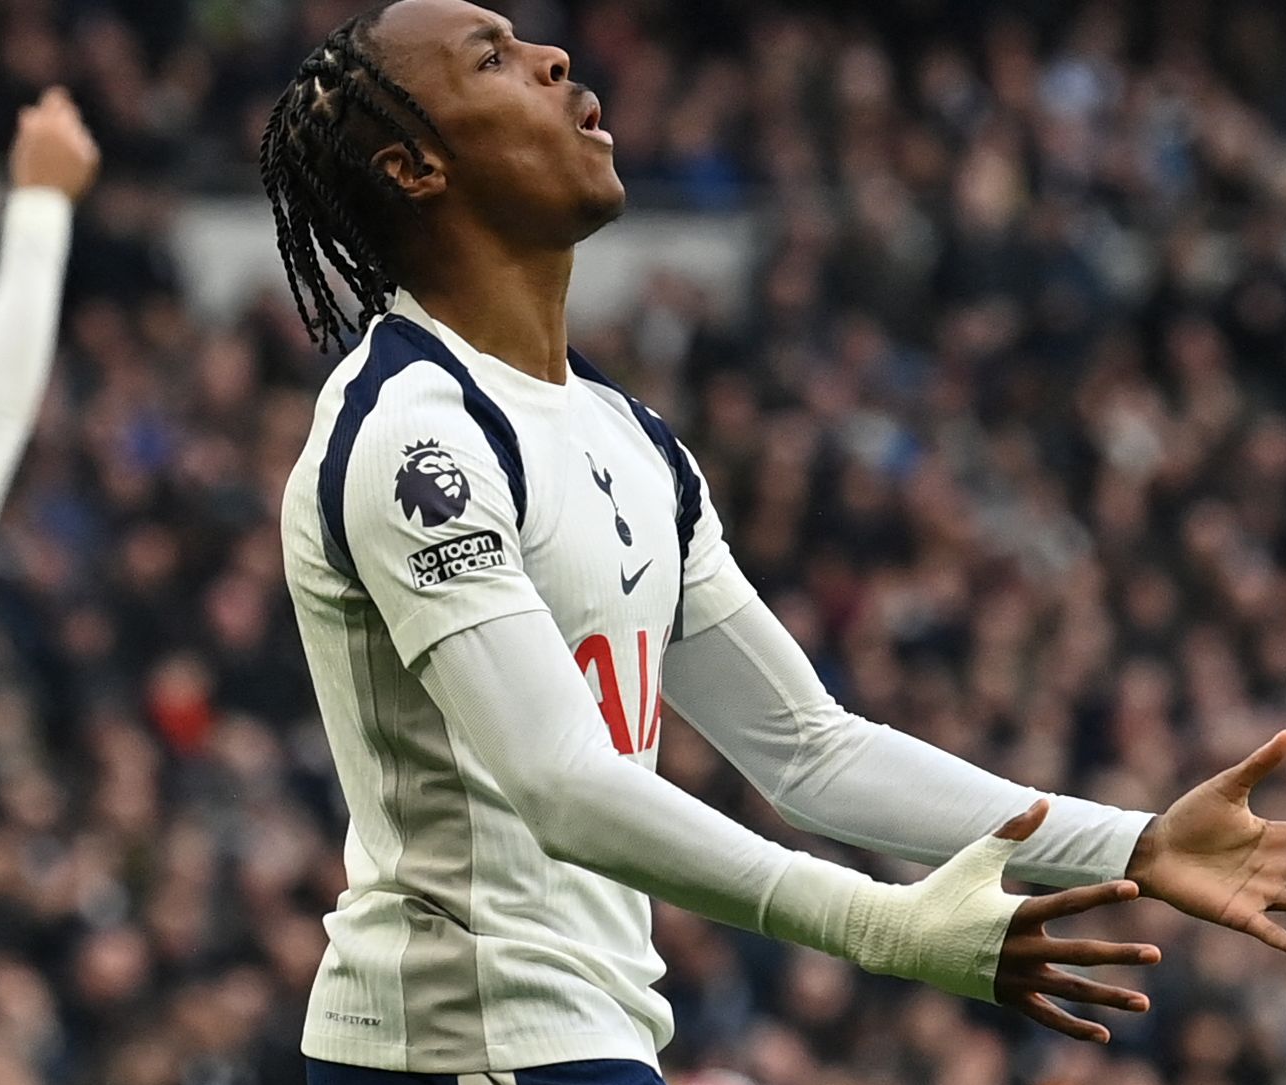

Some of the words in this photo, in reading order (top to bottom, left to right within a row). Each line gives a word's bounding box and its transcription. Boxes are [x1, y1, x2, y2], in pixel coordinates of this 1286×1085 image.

[408, 551, 437, 575] No
[439, 535, 494, 562] room
[442, 549, 506, 578] racism
